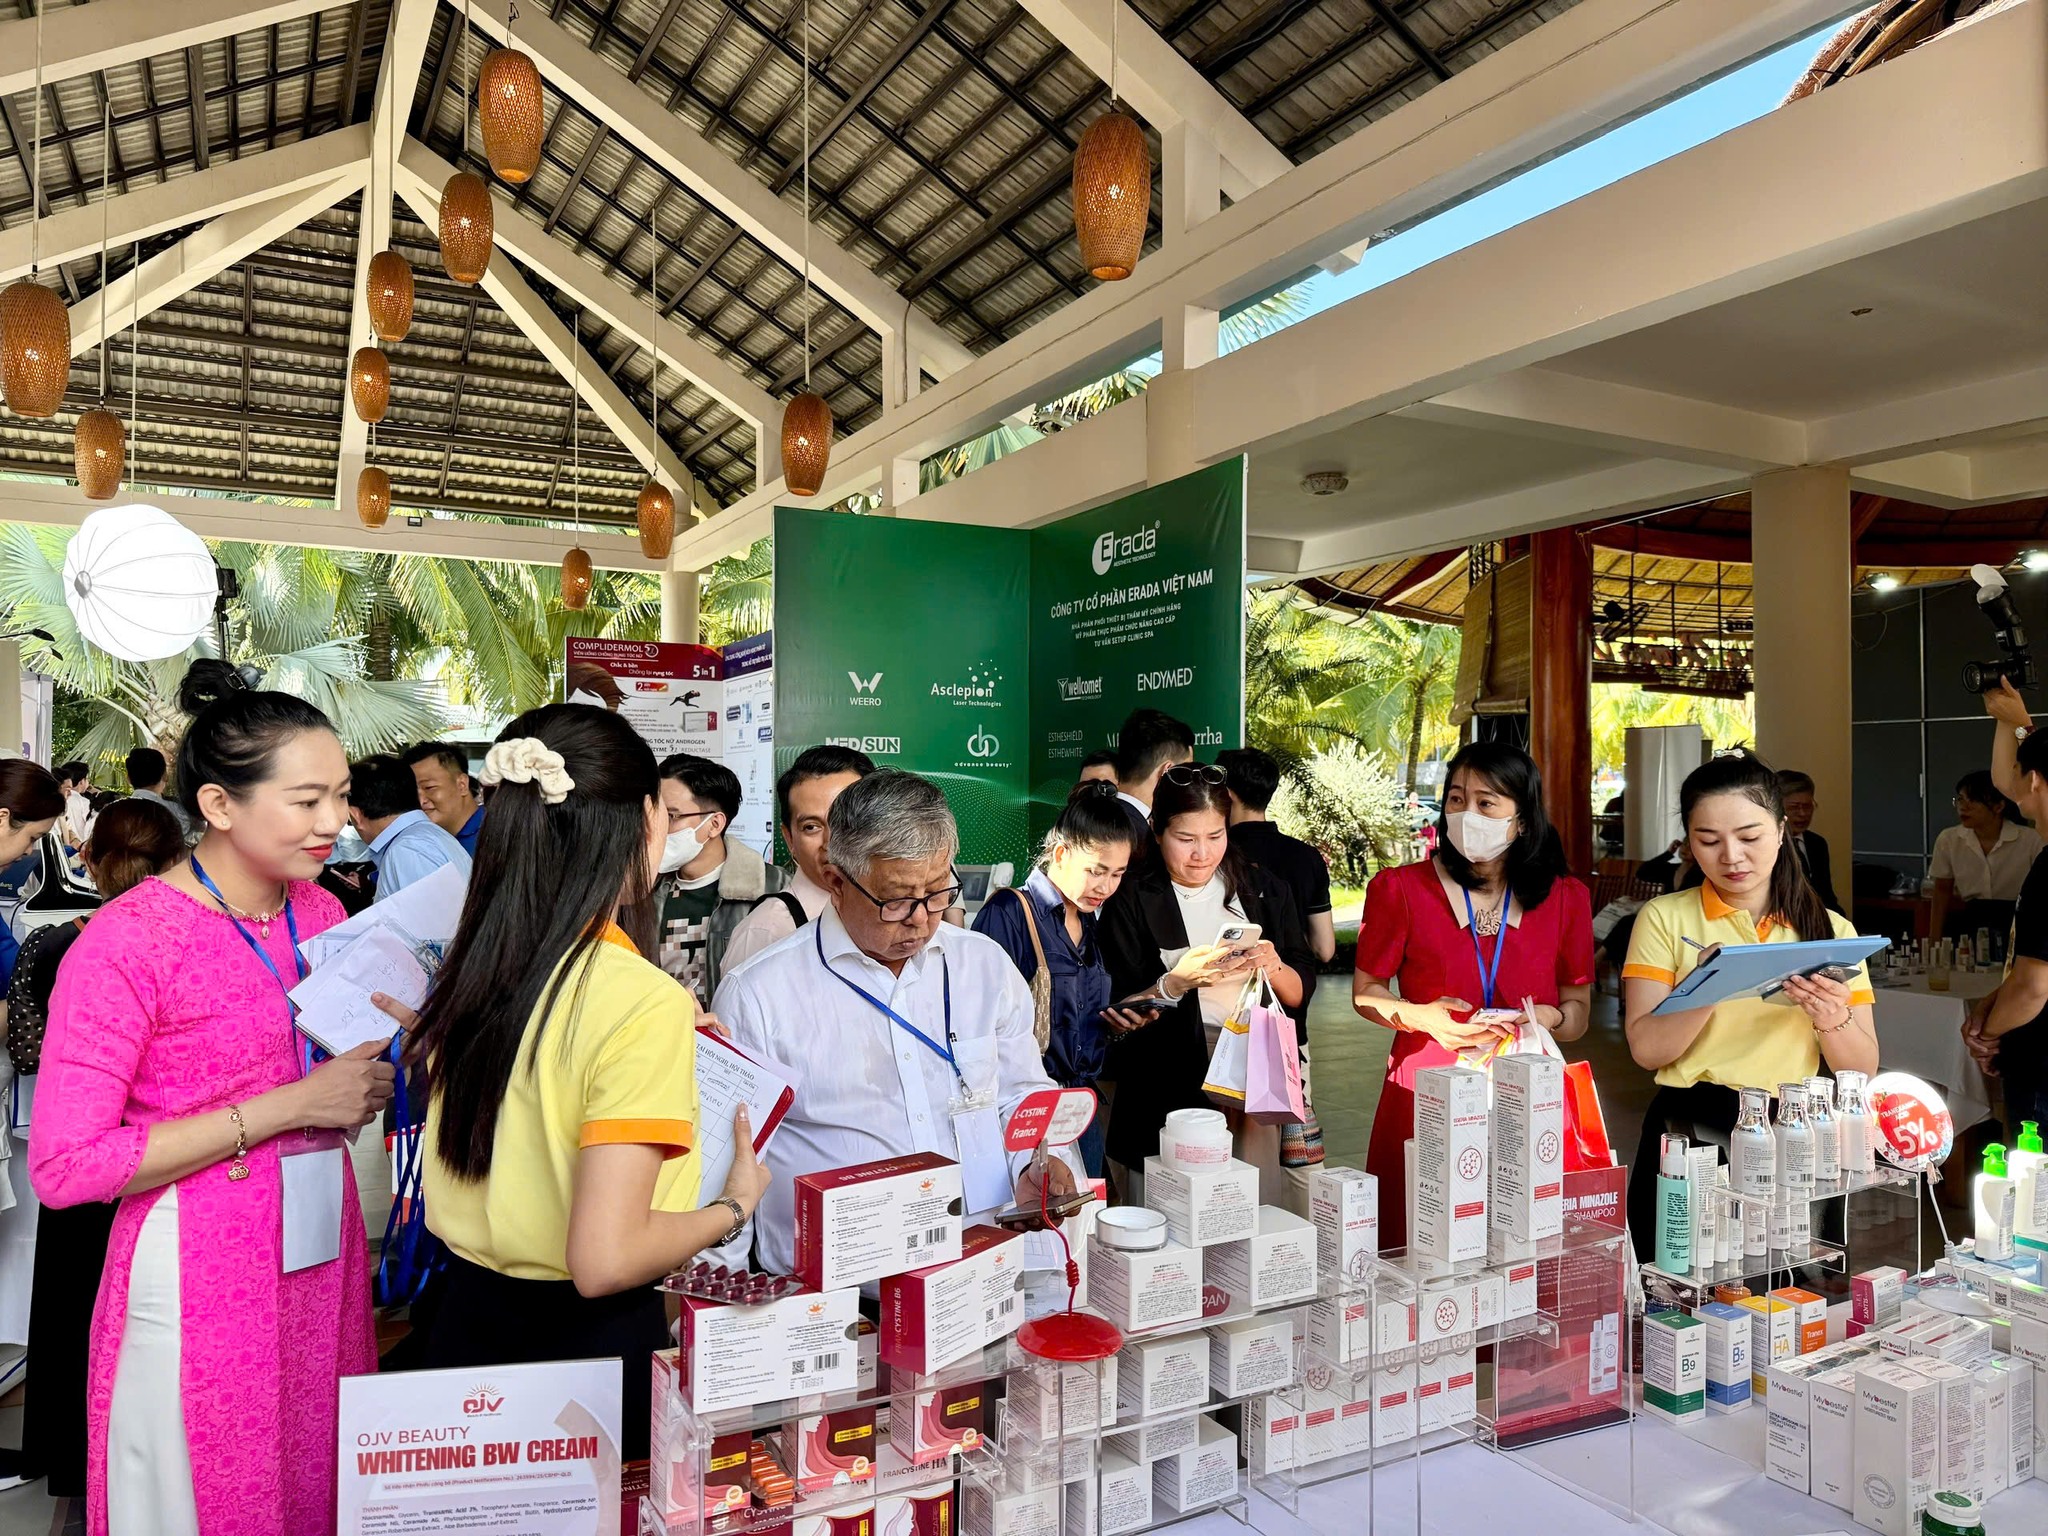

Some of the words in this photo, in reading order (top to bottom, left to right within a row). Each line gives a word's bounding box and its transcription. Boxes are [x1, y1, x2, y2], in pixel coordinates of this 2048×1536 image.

[1102, 525, 1156, 562] Erada
[1051, 600, 1072, 618] CÔNG
[1073, 600, 1084, 612] TY
[1086, 592, 1098, 610] CỔ
[1101, 586, 1125, 607] PHẦN
[1128, 582, 1160, 602] ERADA
[1163, 574, 1185, 595] VIỆT
[1188, 569, 1212, 588] NAM
[1154, 617, 1164, 626] CAO
[1112, 635, 1126, 645] SETUP
[1128, 633, 1143, 642] CLINIC
[1145, 631, 1154, 639] SPA
[573, 642, 643, 653] COMPLIDERMOL
[693, 665, 700, 677] 5
[702, 668, 708, 676] in
[709, 666, 716, 678] 1
[1137, 668, 1193, 691] ENDYMED
[931, 683, 993, 700] Asclepion
[850, 697, 881, 706] WEERO
[1195, 726, 1222, 745] rrha
[1048, 747, 1082, 758] ESTHEWHITE
[1014, 1107, 1048, 1120] L-CYSTINE
[1012, 1127, 1038, 1139] France
[1893, 1118, 1938, 1154] 5%
[1562, 1199, 1577, 1210] ERIA
[1580, 1192, 1618, 1208] MINAZOLE
[1201, 1293, 1226, 1313] PAN
[1807, 1329, 1824, 1338] Tranex
[1733, 1347, 1744, 1363] B5
[1774, 1338, 1789, 1356] HA
[1682, 1358, 1695, 1372] B9
[357, 1432, 393, 1447] OJV
[399, 1426, 470, 1444] BEAUTY
[357, 1444, 476, 1476] WHITENING
[483, 1441, 520, 1466] BW
[527, 1436, 598, 1462] CREAM
[883, 1462, 930, 1479] FRANCYSTINE
[931, 1457, 948, 1470] HA
